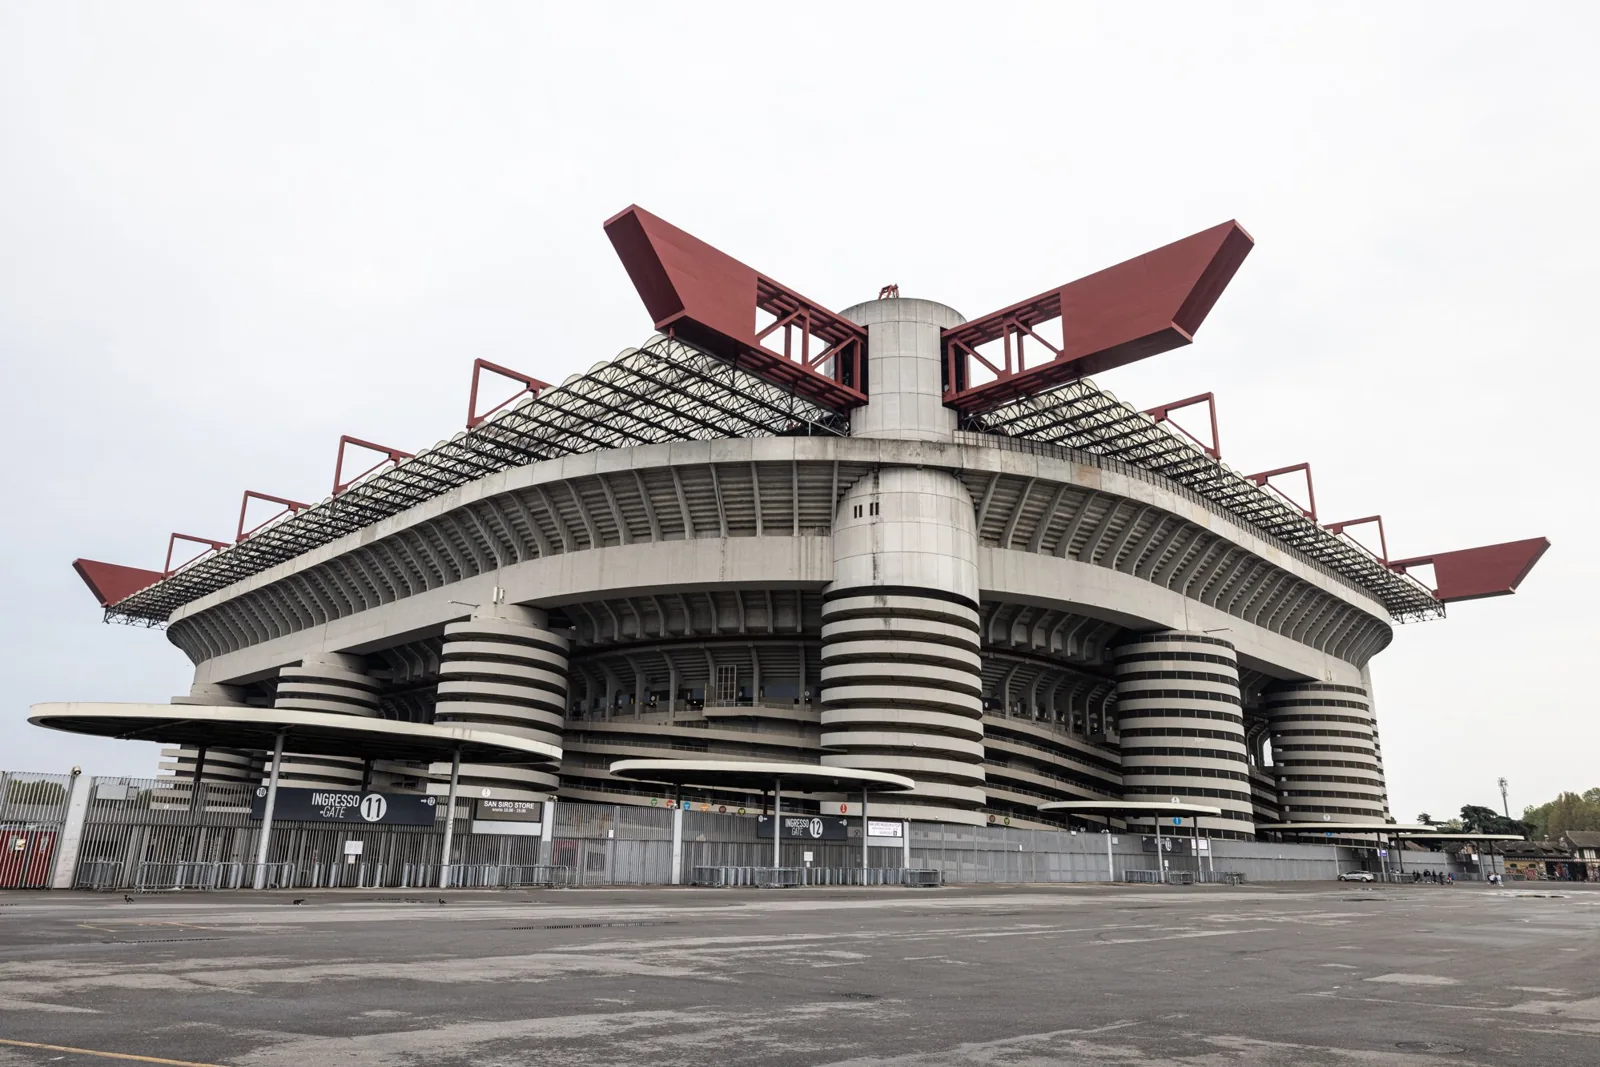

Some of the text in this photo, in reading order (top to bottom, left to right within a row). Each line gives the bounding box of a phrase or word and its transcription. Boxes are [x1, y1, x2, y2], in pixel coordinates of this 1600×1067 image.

[311, 792, 360, 807] INGRESSO
[365, 797, 382, 818] 11
[785, 818, 810, 828] INGRESSO
[811, 820, 821, 836] 12
[791, 827, 803, 836] GATE
